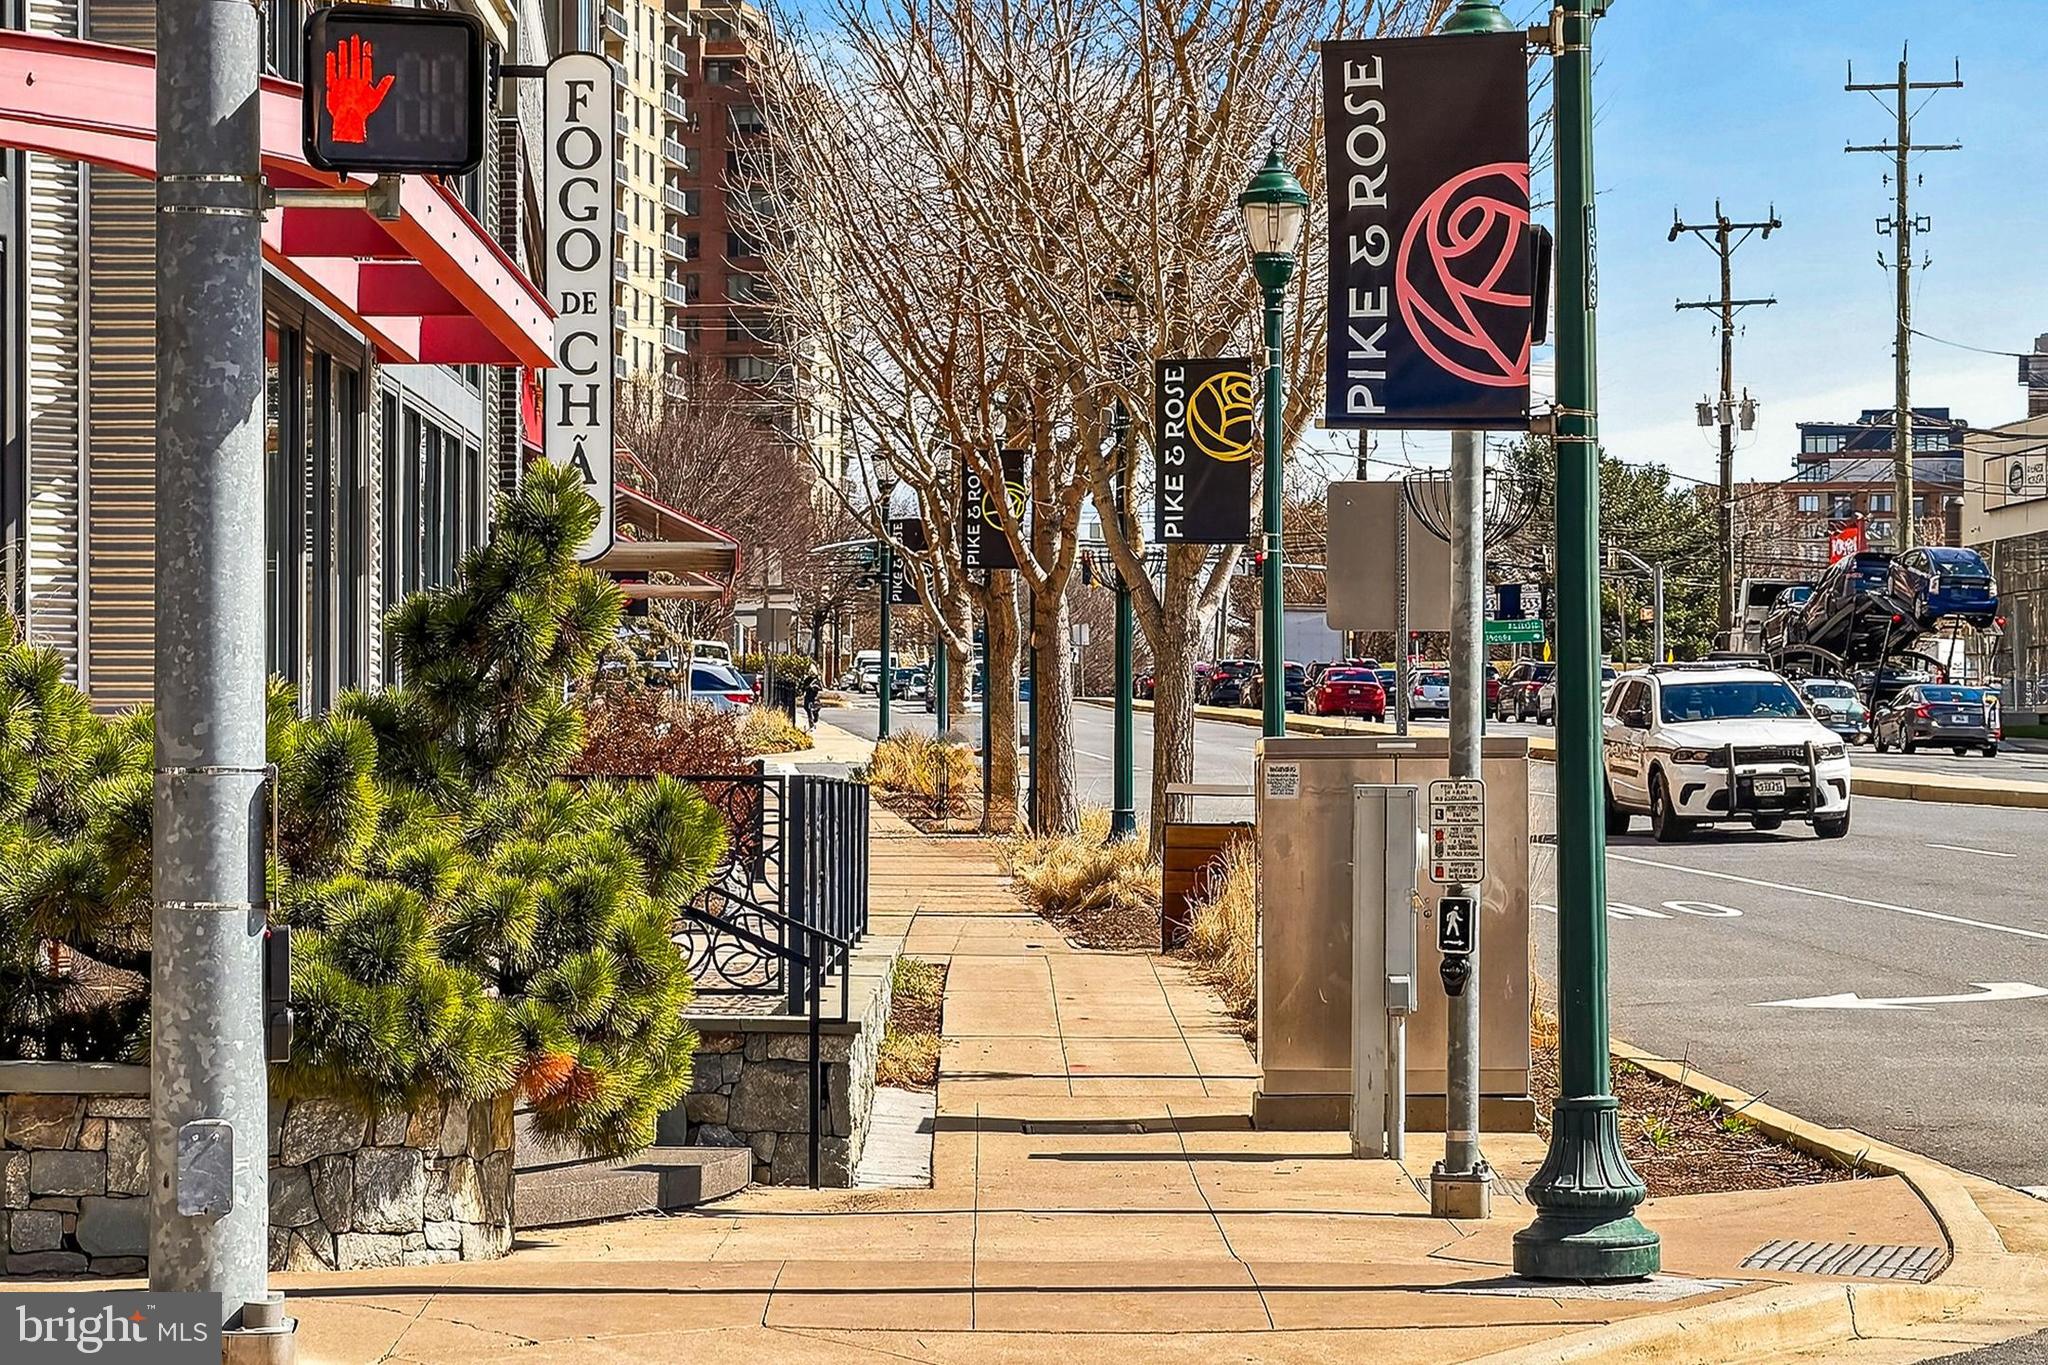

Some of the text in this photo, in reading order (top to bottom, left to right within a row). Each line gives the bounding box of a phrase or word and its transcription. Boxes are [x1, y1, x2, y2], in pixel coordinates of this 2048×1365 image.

[1343, 55, 1391, 414] PIKE & ROSE
[556, 80, 602, 532] FOGO DE CHÃ
[1164, 365, 1186, 538] PIKE & ROSE
[966, 505, 982, 519] &
[966, 524, 980, 565] PIKE
[892, 571, 903, 602] PIKE
